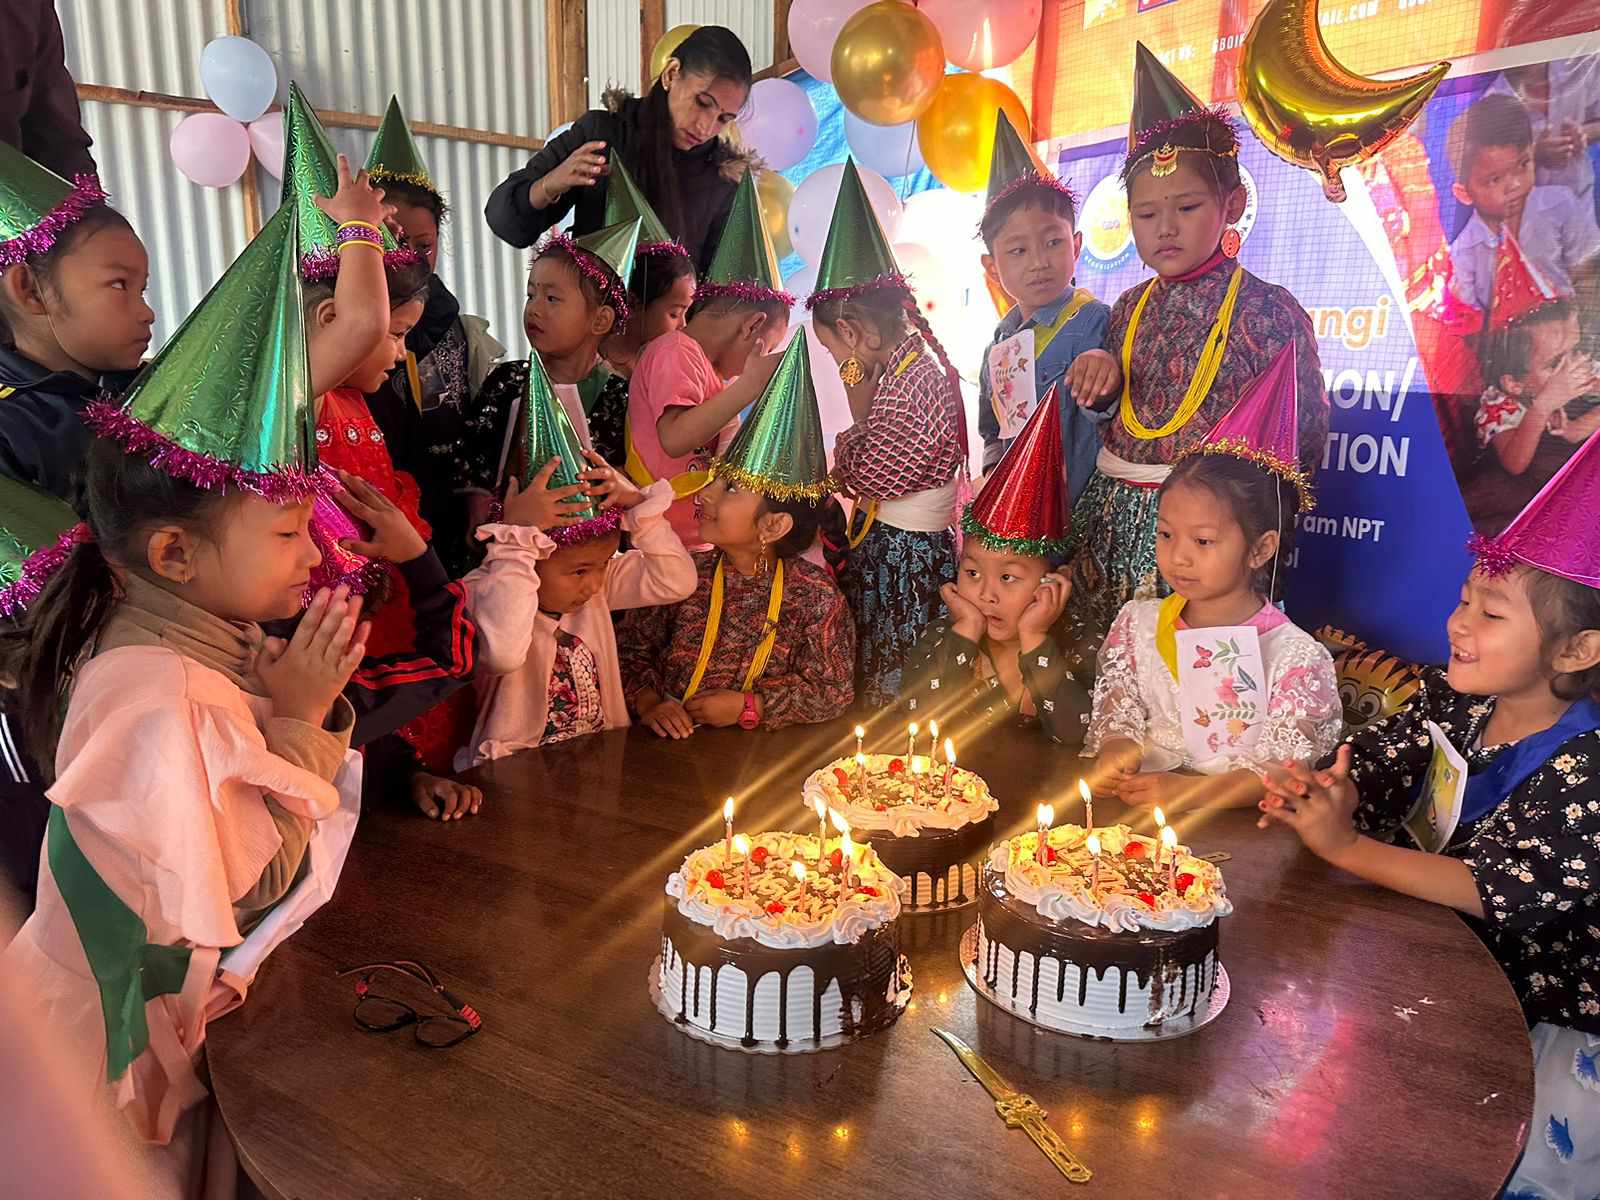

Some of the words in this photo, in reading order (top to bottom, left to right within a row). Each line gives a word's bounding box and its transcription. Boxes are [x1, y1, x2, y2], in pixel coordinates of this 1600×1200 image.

[1318, 1, 1377, 27] AIL.COM
[1311, 295, 1391, 349] ngi
[1321, 432, 1410, 477] TION
[1303, 515, 1338, 536] am
[1342, 516, 1385, 542] NPT
